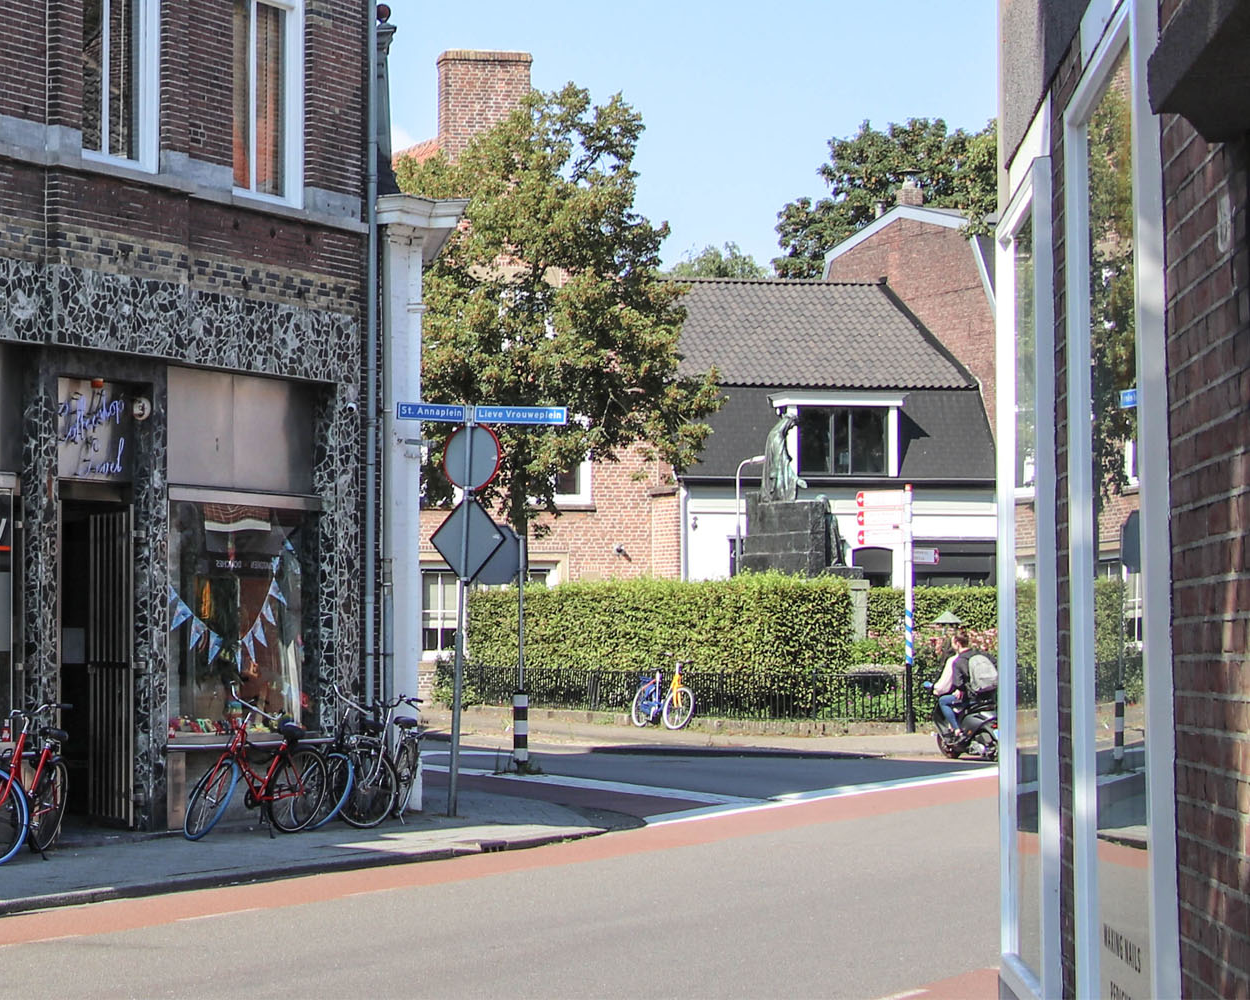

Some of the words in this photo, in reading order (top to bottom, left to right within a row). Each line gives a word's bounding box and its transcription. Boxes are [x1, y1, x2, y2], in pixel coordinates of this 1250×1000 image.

[401, 405, 414, 415] St.
[416, 407, 462, 418] Annaplein
[478, 409, 503, 418] Lieve
[505, 410, 562, 420] Vrouweplein
[1124, 938, 1142, 974] NAILS
